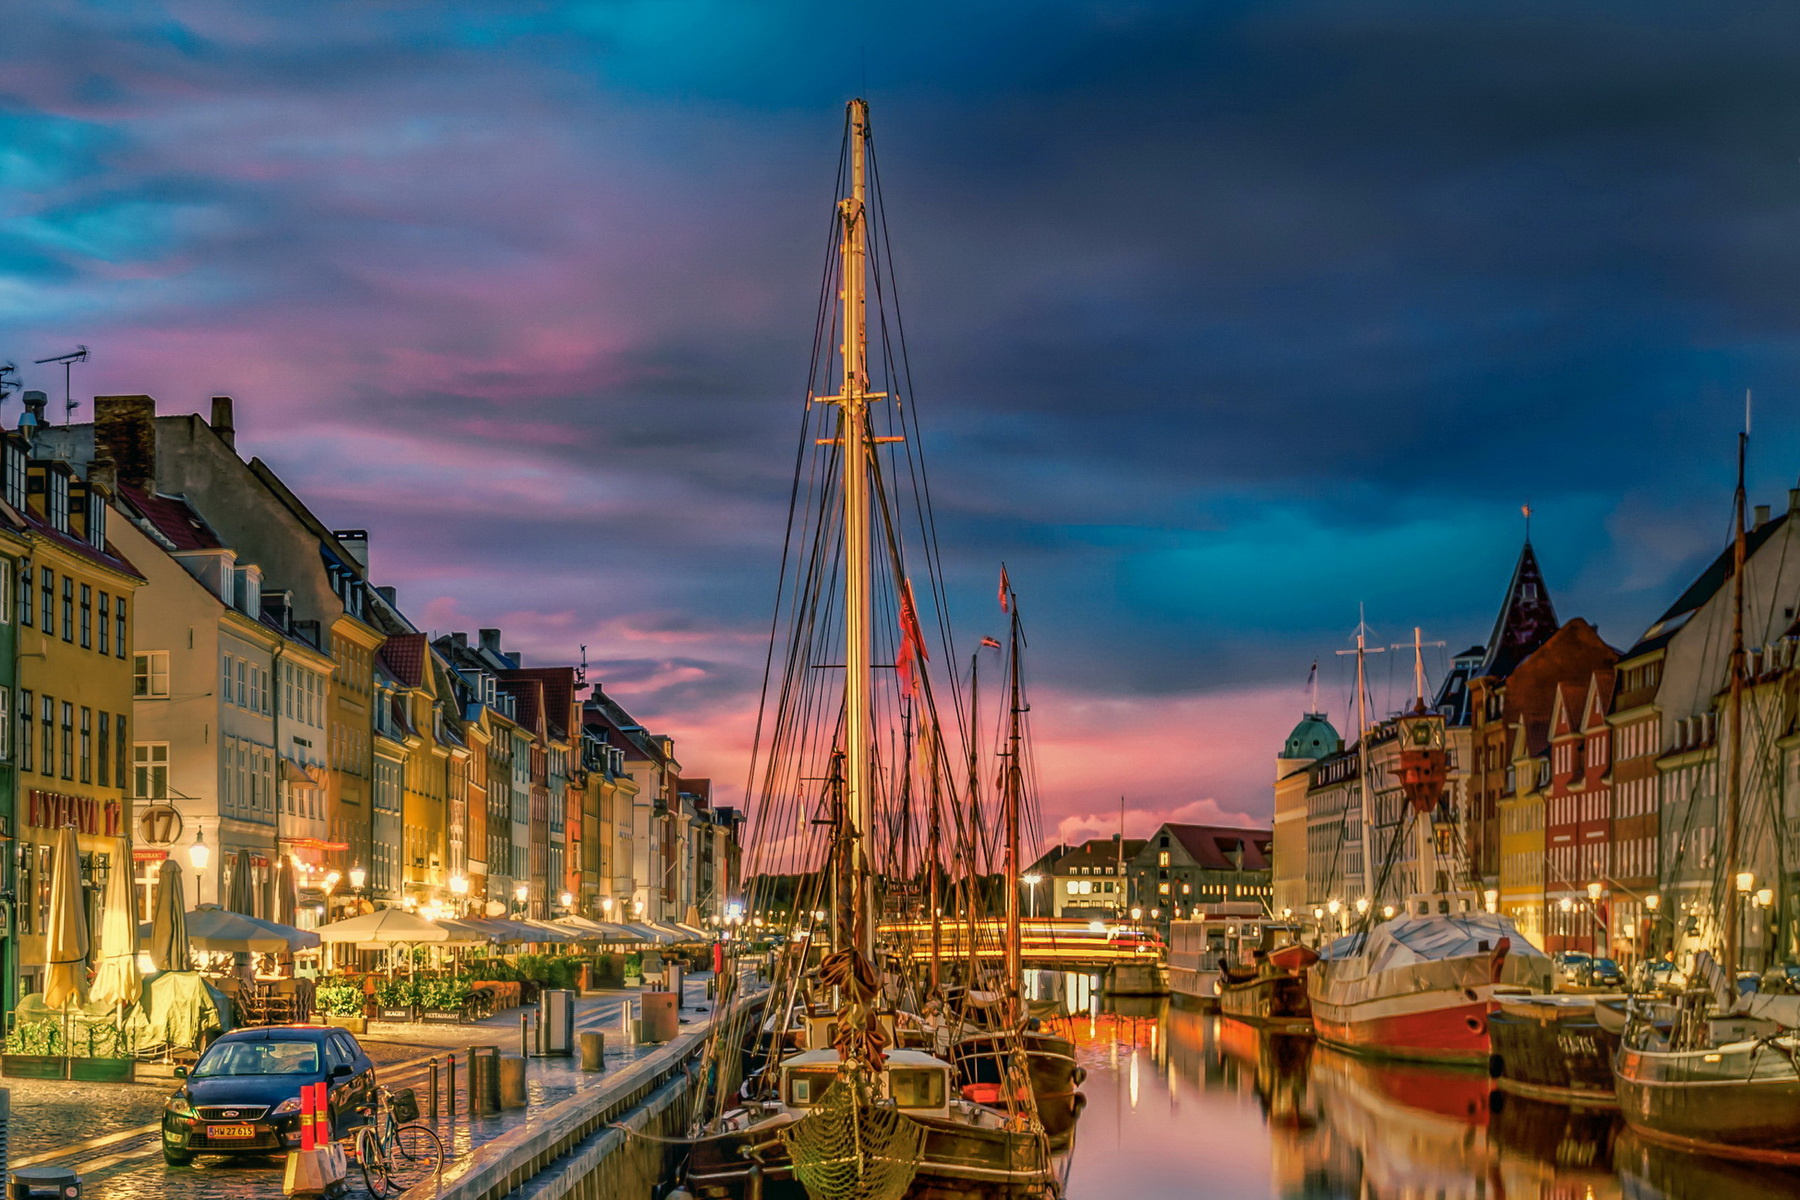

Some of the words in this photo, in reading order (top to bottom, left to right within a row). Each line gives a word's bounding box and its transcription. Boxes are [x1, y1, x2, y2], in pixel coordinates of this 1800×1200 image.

[29, 788, 100, 836] NYHAVN
[141, 811, 175, 843] 17
[425, 1012, 459, 1020] RESTAURANT
[226, 1127, 236, 1136] 27
[237, 1127, 253, 1136] 615
